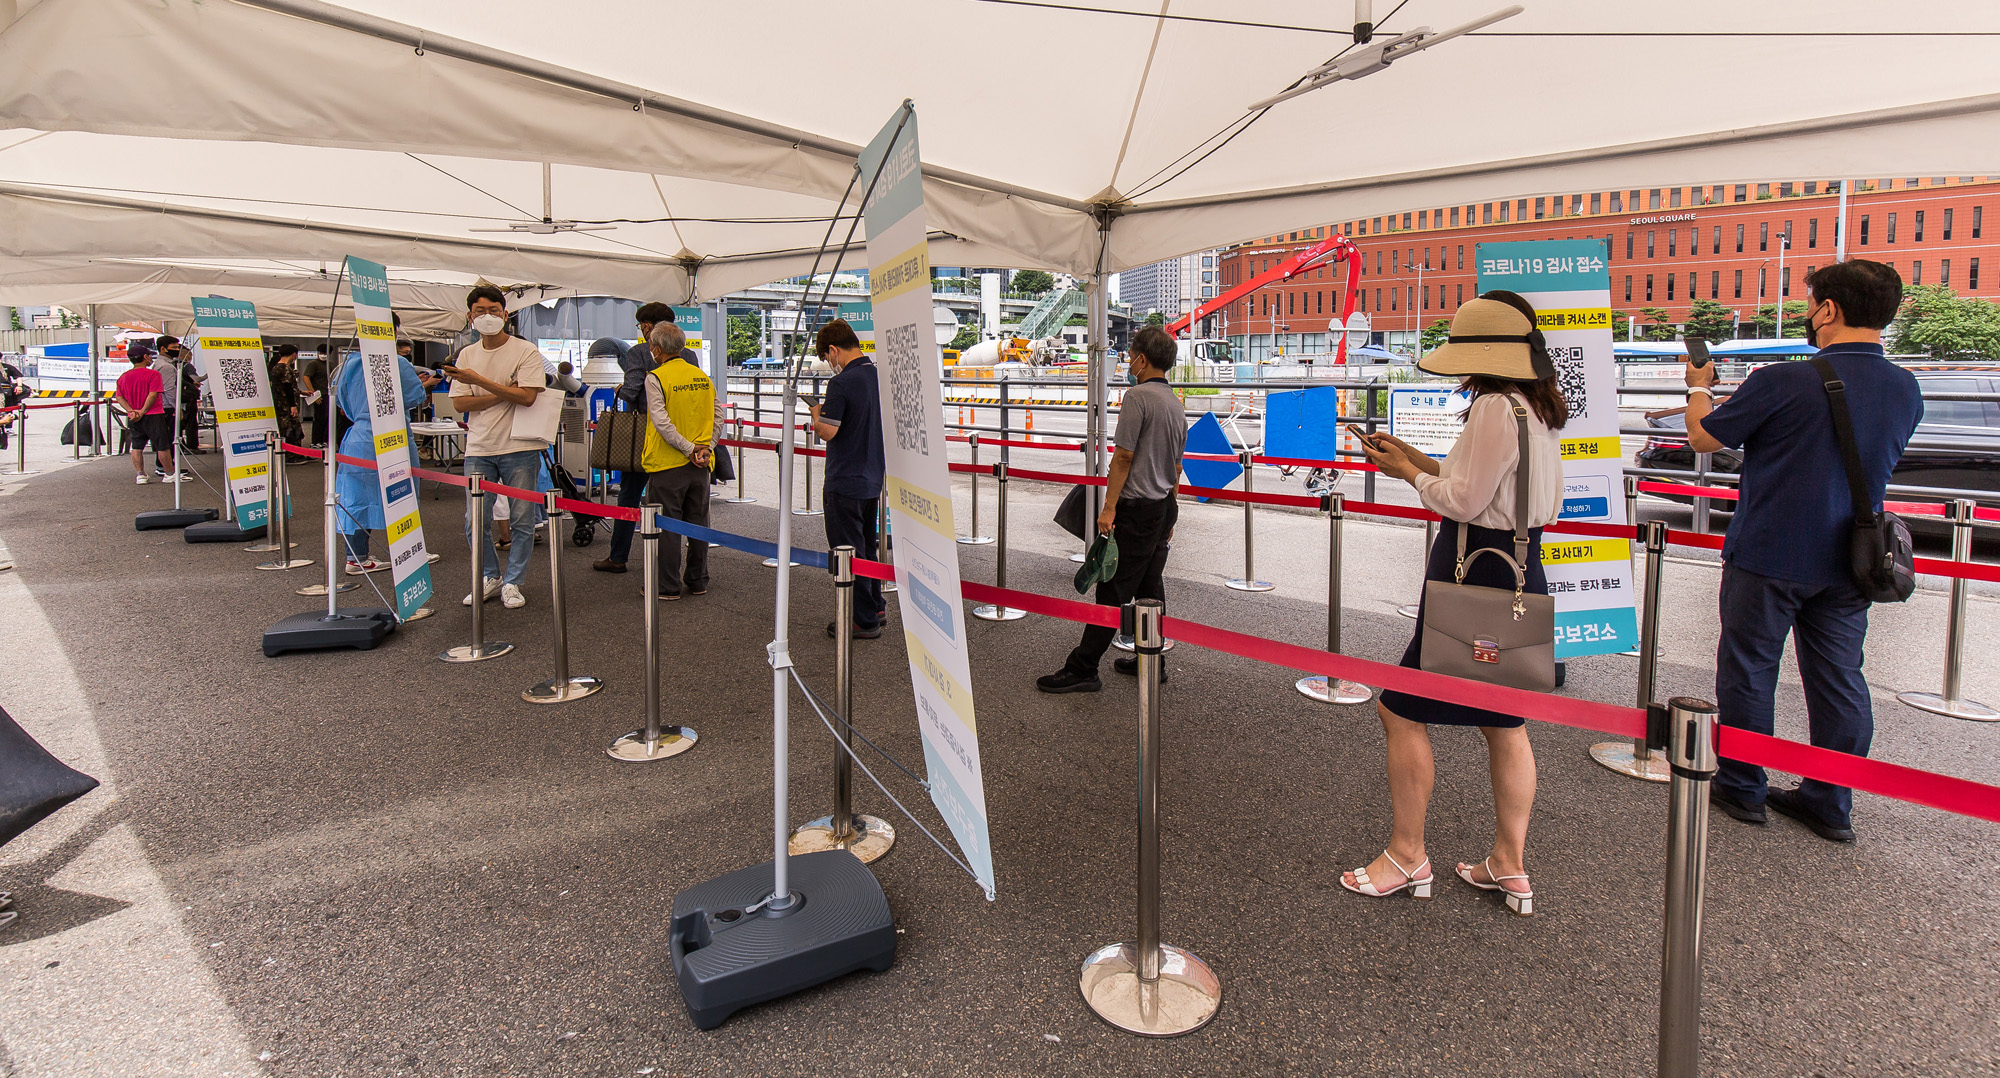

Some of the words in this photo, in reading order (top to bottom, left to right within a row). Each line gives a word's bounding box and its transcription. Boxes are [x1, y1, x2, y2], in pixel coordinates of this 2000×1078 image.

[1630, 216, 1658, 225] SEOUL
[1660, 213, 1696, 222] SQUARE
[1482, 258, 1543, 275] 코로나19
[1546, 257, 1574, 274] 검사
[1576, 256, 1604, 273] 접수
[196, 307, 227, 318] 코로나19
[228, 308, 241, 319] 검사
[242, 310, 254, 319] 접수
[1567, 314, 1586, 325] 켜서
[1588, 312, 1607, 324] 스캔
[1579, 443, 1598, 454] 작성
[253, 465, 267, 474] 검사대
[1564, 484, 1590, 492] 구보건소
[248, 509, 267, 521] 중구보
[1551, 545, 1593, 560] 검사대기
[1547, 581, 1576, 593] 결과는
[1580, 579, 1600, 591] 문자
[1601, 578, 1621, 590] 통보
[403, 578, 427, 608] 중구보건소
[1554, 623, 1617, 645] 구보건소
